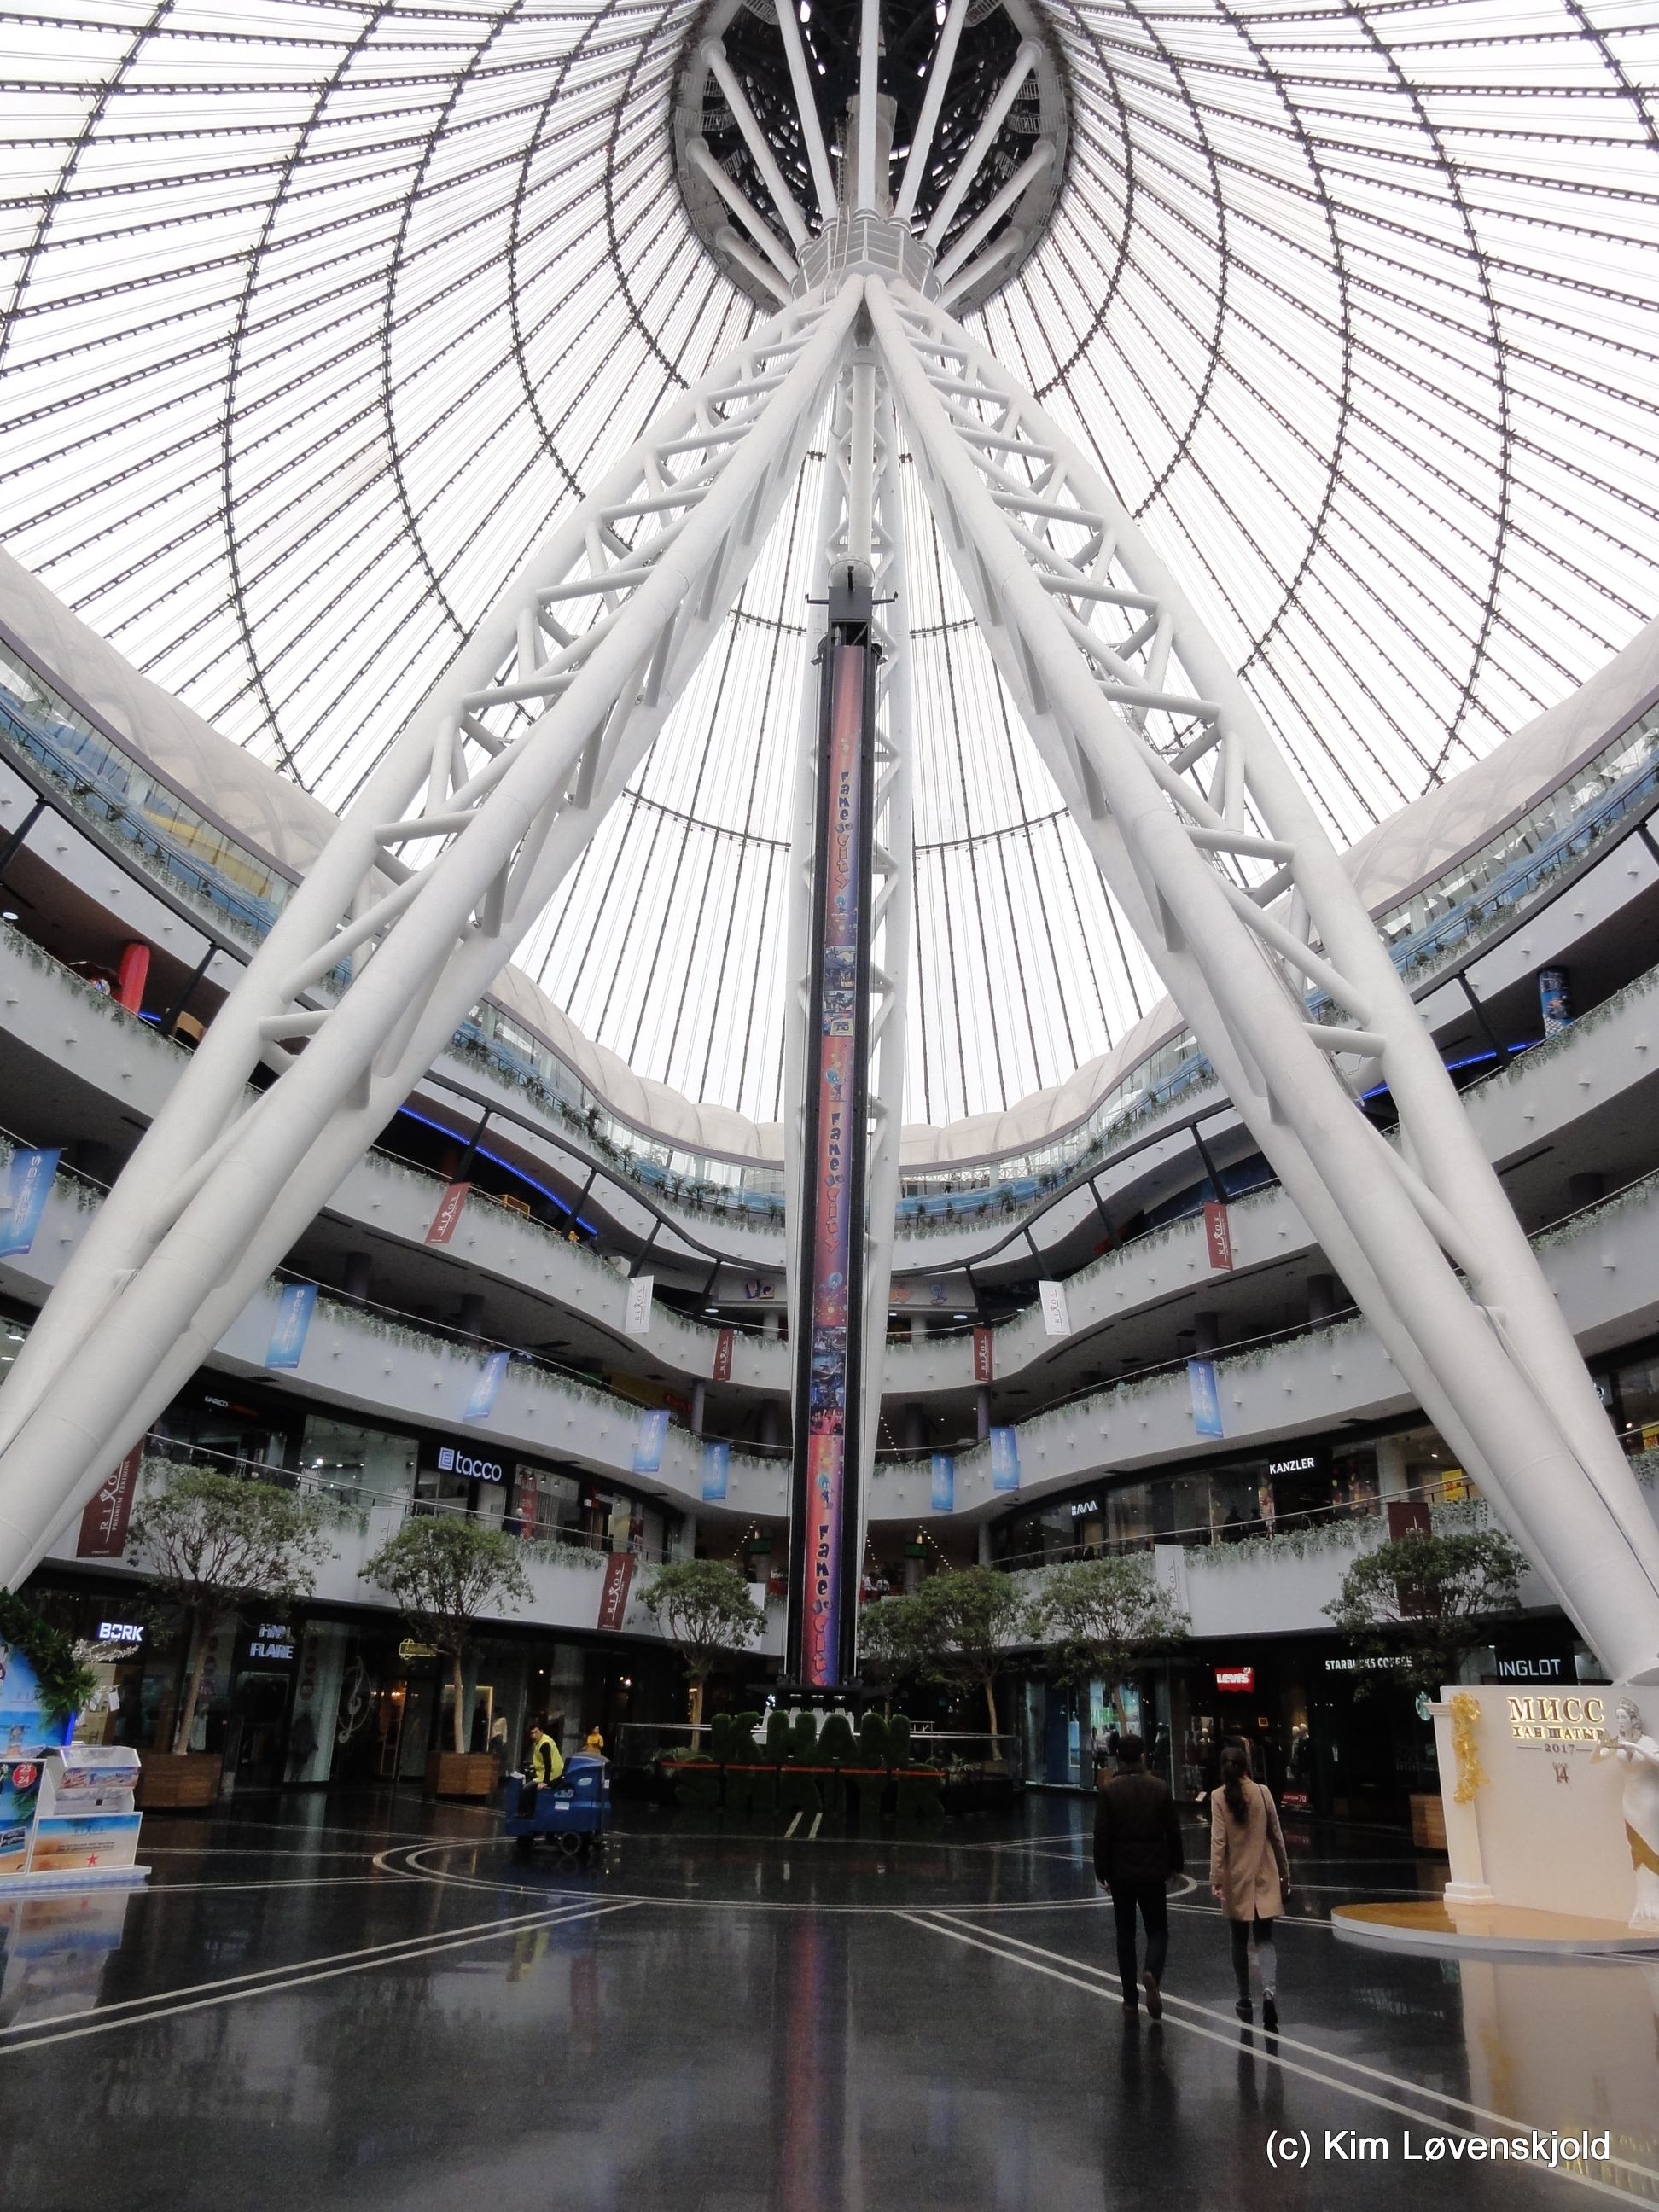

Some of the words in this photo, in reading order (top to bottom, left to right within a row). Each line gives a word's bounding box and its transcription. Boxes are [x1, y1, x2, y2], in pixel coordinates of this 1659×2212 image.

[438, 1196, 457, 1231] RIXOS
[1214, 1217, 1225, 1255] RIXOS
[1050, 1292, 1060, 1324] RIXOS
[455, 1449, 503, 1481] tacco
[1269, 1457, 1315, 1475] KANZLER
[100, 1473, 118, 1531] RIXO
[111, 1496, 124, 1531] PREMIUM
[815, 1524, 830, 1596] Fame
[607, 1569, 622, 1614] RIXOS
[99, 1622, 144, 1642] BORK
[249, 1643, 294, 1659] FLARE
[1499, 1658, 1561, 1678] INGLOT
[1507, 1697, 1605, 1724] МИСС
[1512, 1726, 1545, 1740] ХАН
[1544, 1743, 1575, 1754] 2017
[18, 1776, 30, 1784] 24
[20, 1764, 32, 1773] 23
